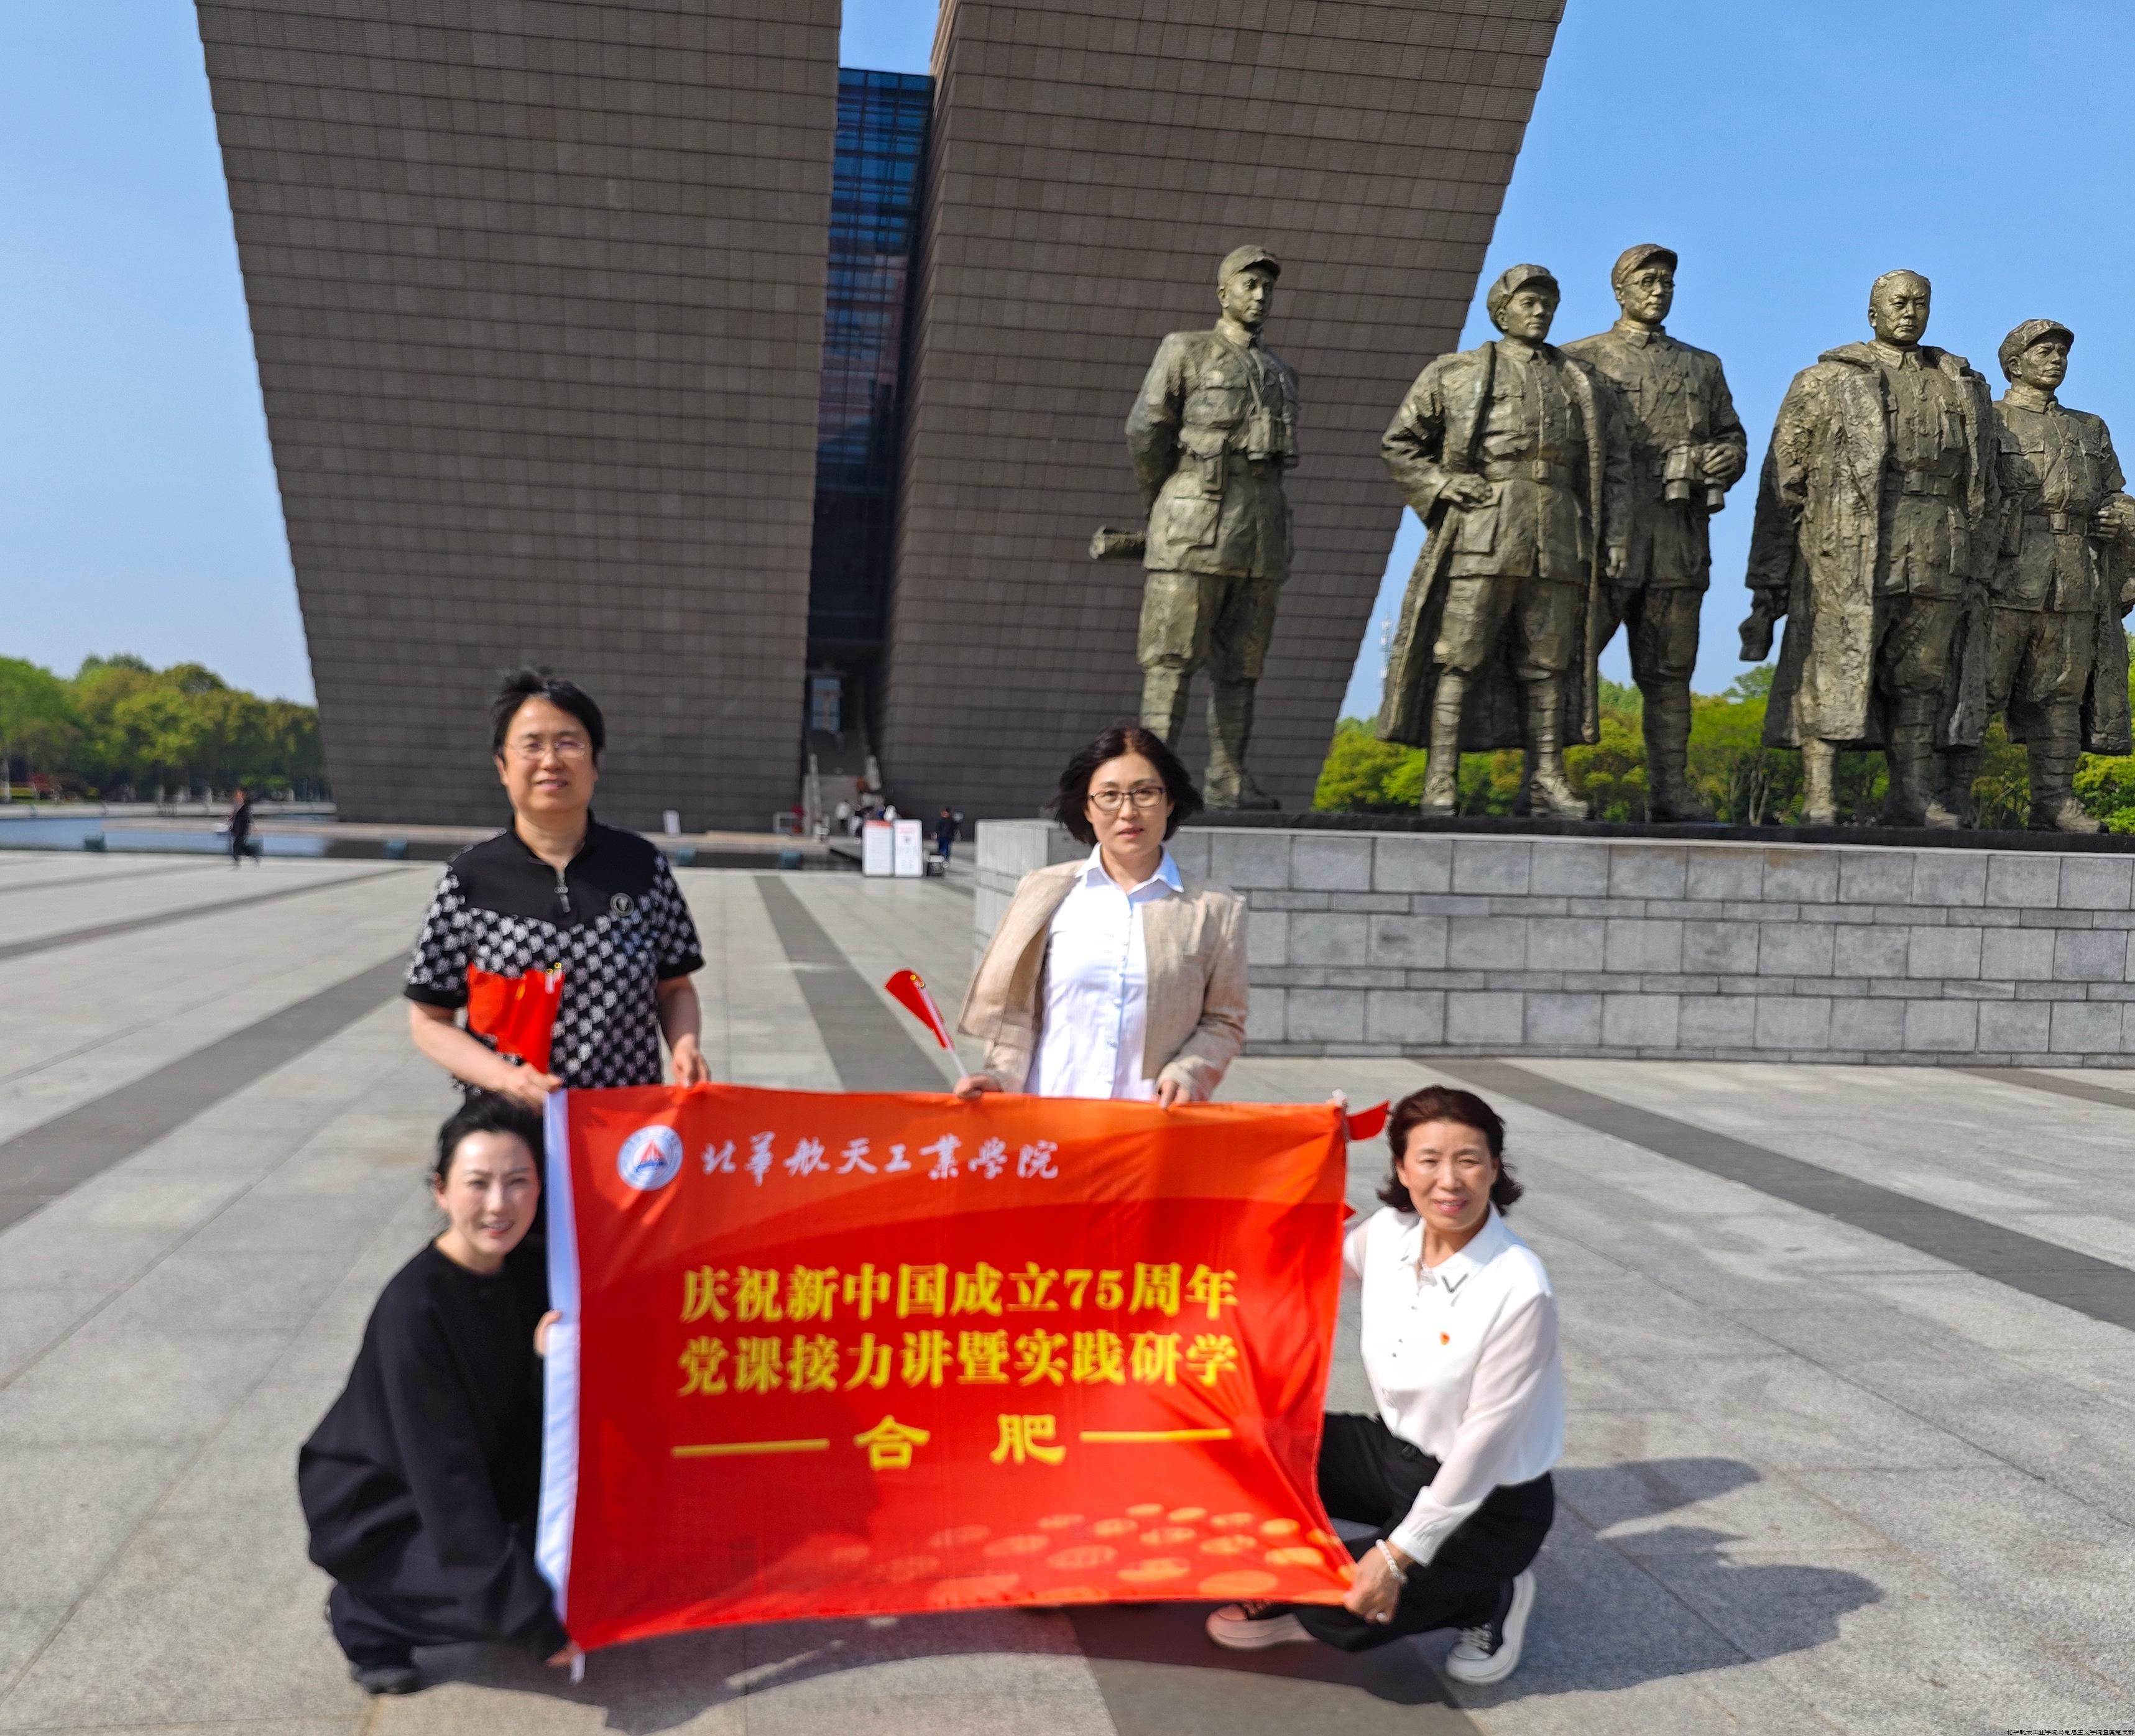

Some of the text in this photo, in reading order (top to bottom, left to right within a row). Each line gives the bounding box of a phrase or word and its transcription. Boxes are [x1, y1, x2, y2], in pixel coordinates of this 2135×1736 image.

[681, 1261, 1241, 1323] 庆祝新中国成立75周年
[678, 1328, 1240, 1397] 党课接力讲暨实践研学
